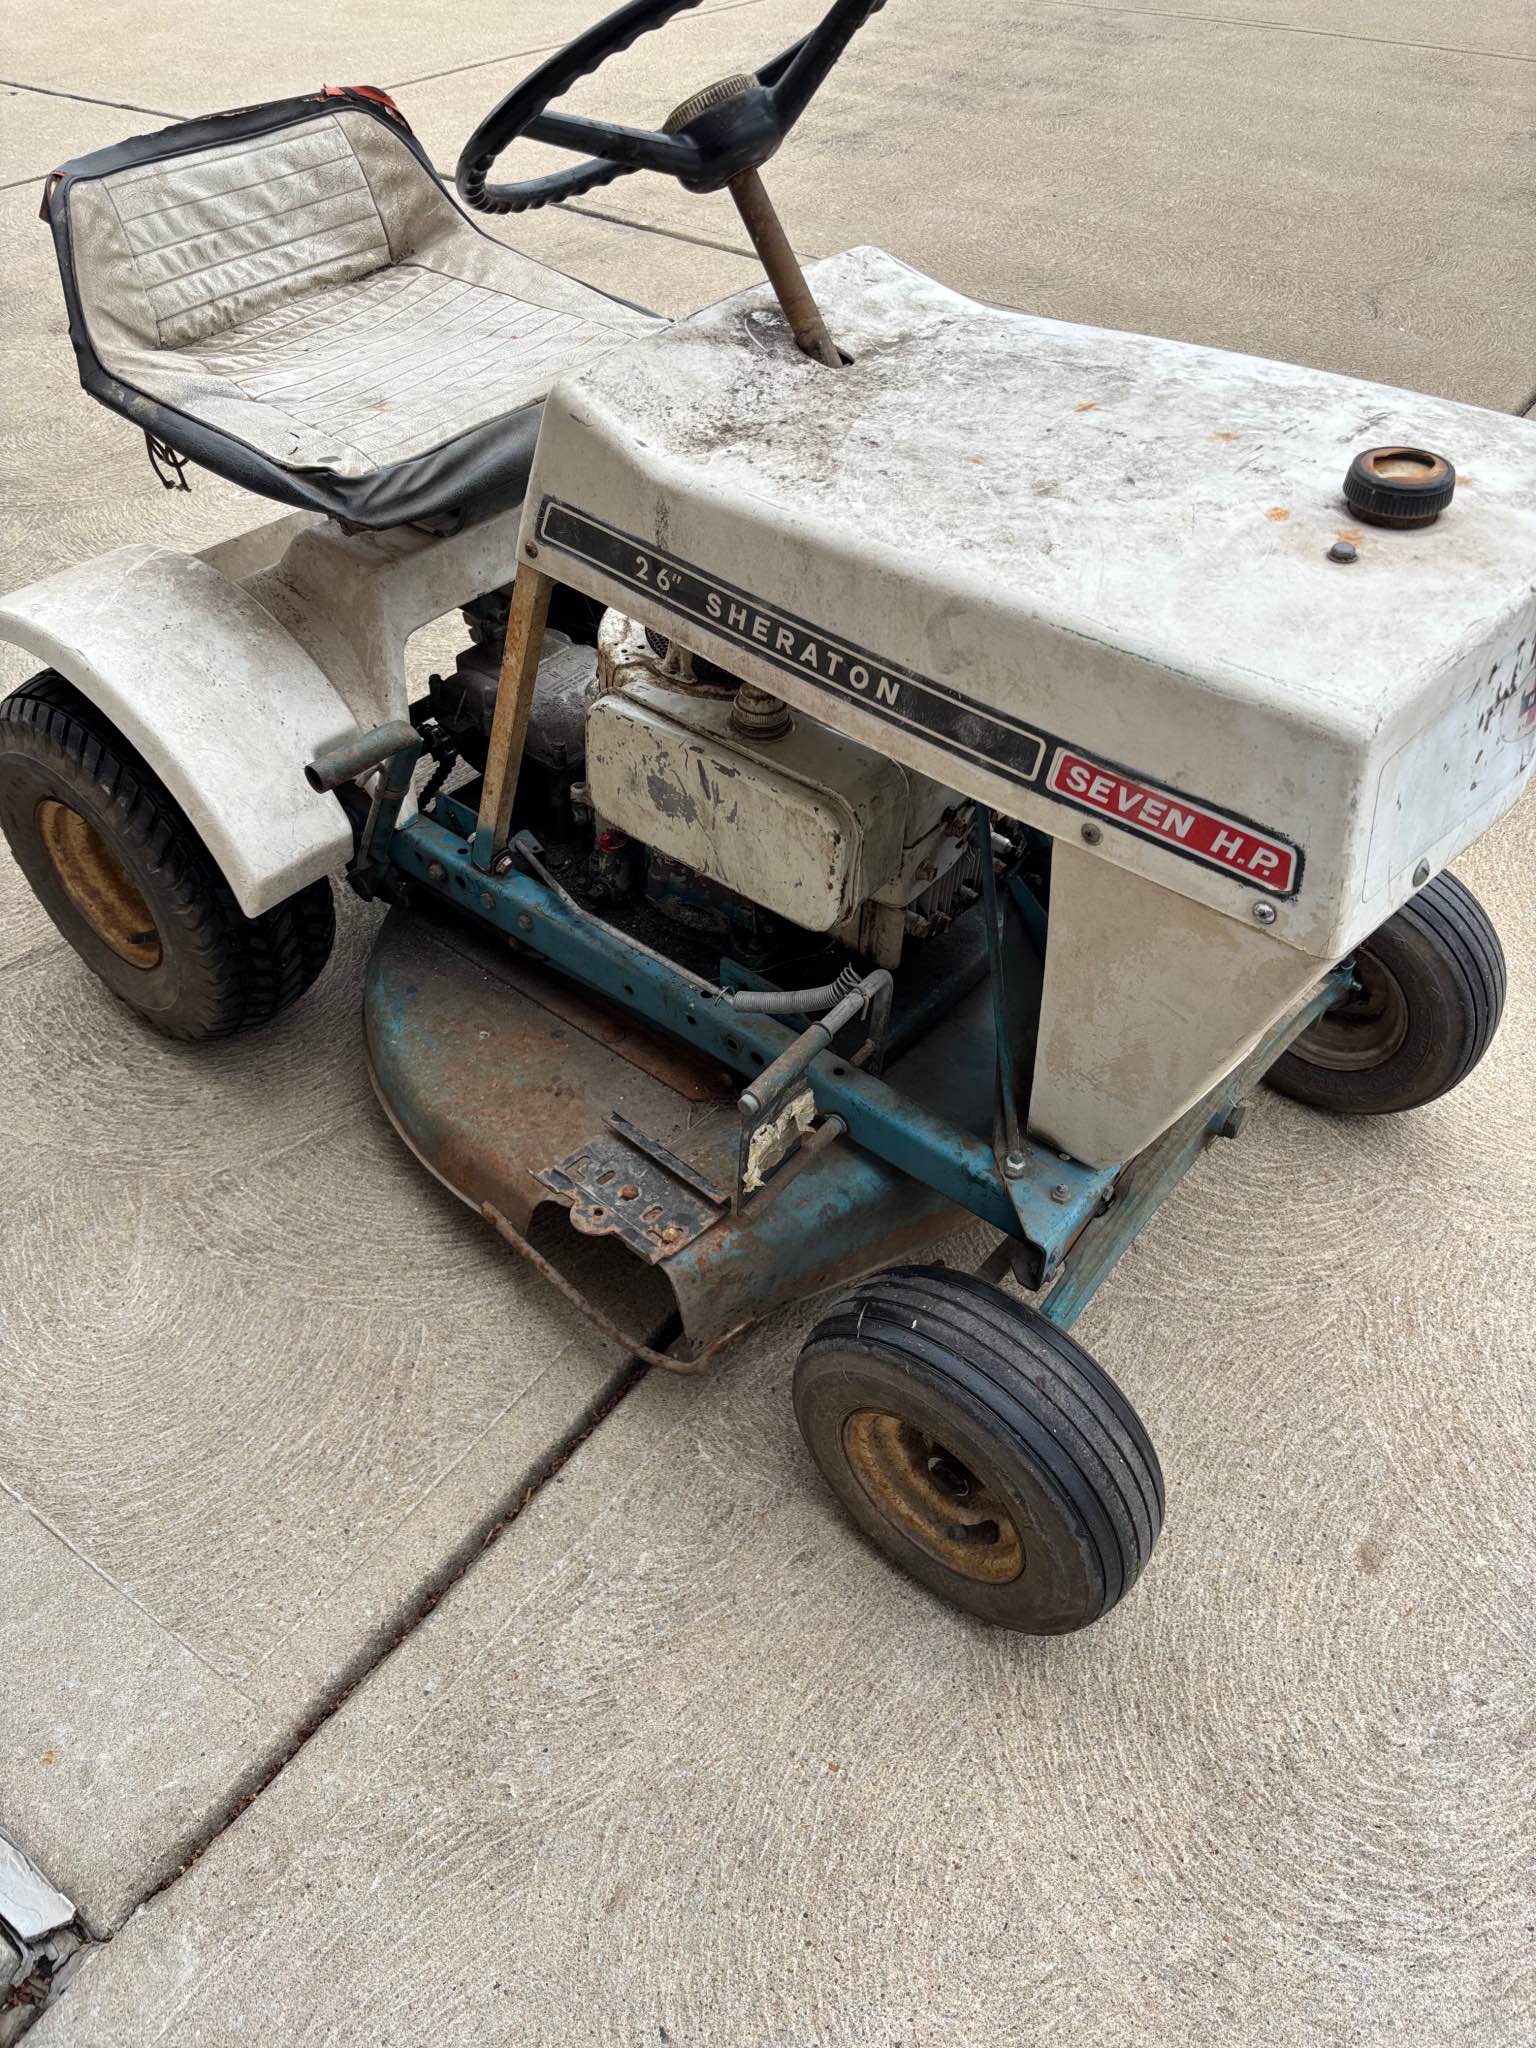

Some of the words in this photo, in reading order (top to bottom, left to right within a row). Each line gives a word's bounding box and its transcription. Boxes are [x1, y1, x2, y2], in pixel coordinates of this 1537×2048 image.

[635, 557, 682, 592] 26"
[706, 593, 900, 705] SHERATON
[1066, 766, 1194, 838] SEVEN
[1211, 831, 1279, 876] H.P.
